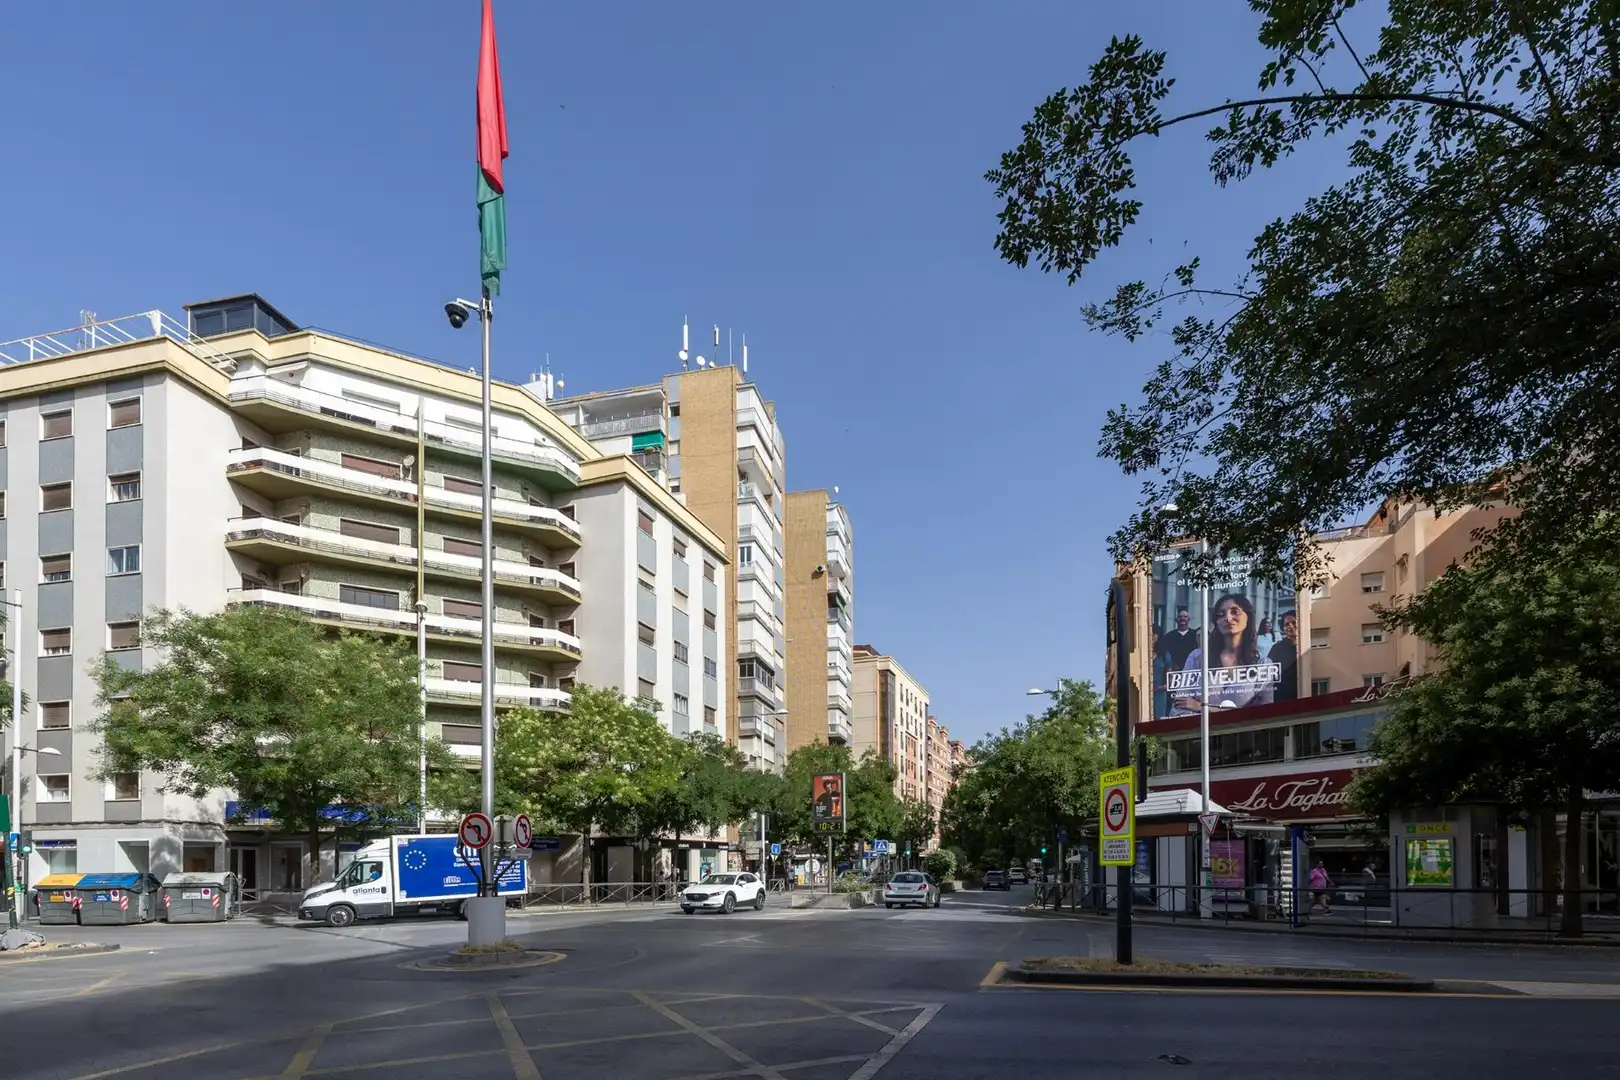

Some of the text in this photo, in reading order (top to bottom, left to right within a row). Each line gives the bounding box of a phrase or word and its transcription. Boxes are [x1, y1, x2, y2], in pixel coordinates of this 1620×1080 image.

[1177, 578, 1185, 586] el
[1211, 578, 1249, 590] mundo?
[1103, 771, 1130, 783] ATENCIÓN
[1227, 782, 1268, 811] La
[352, 886, 381, 895] atlanta
